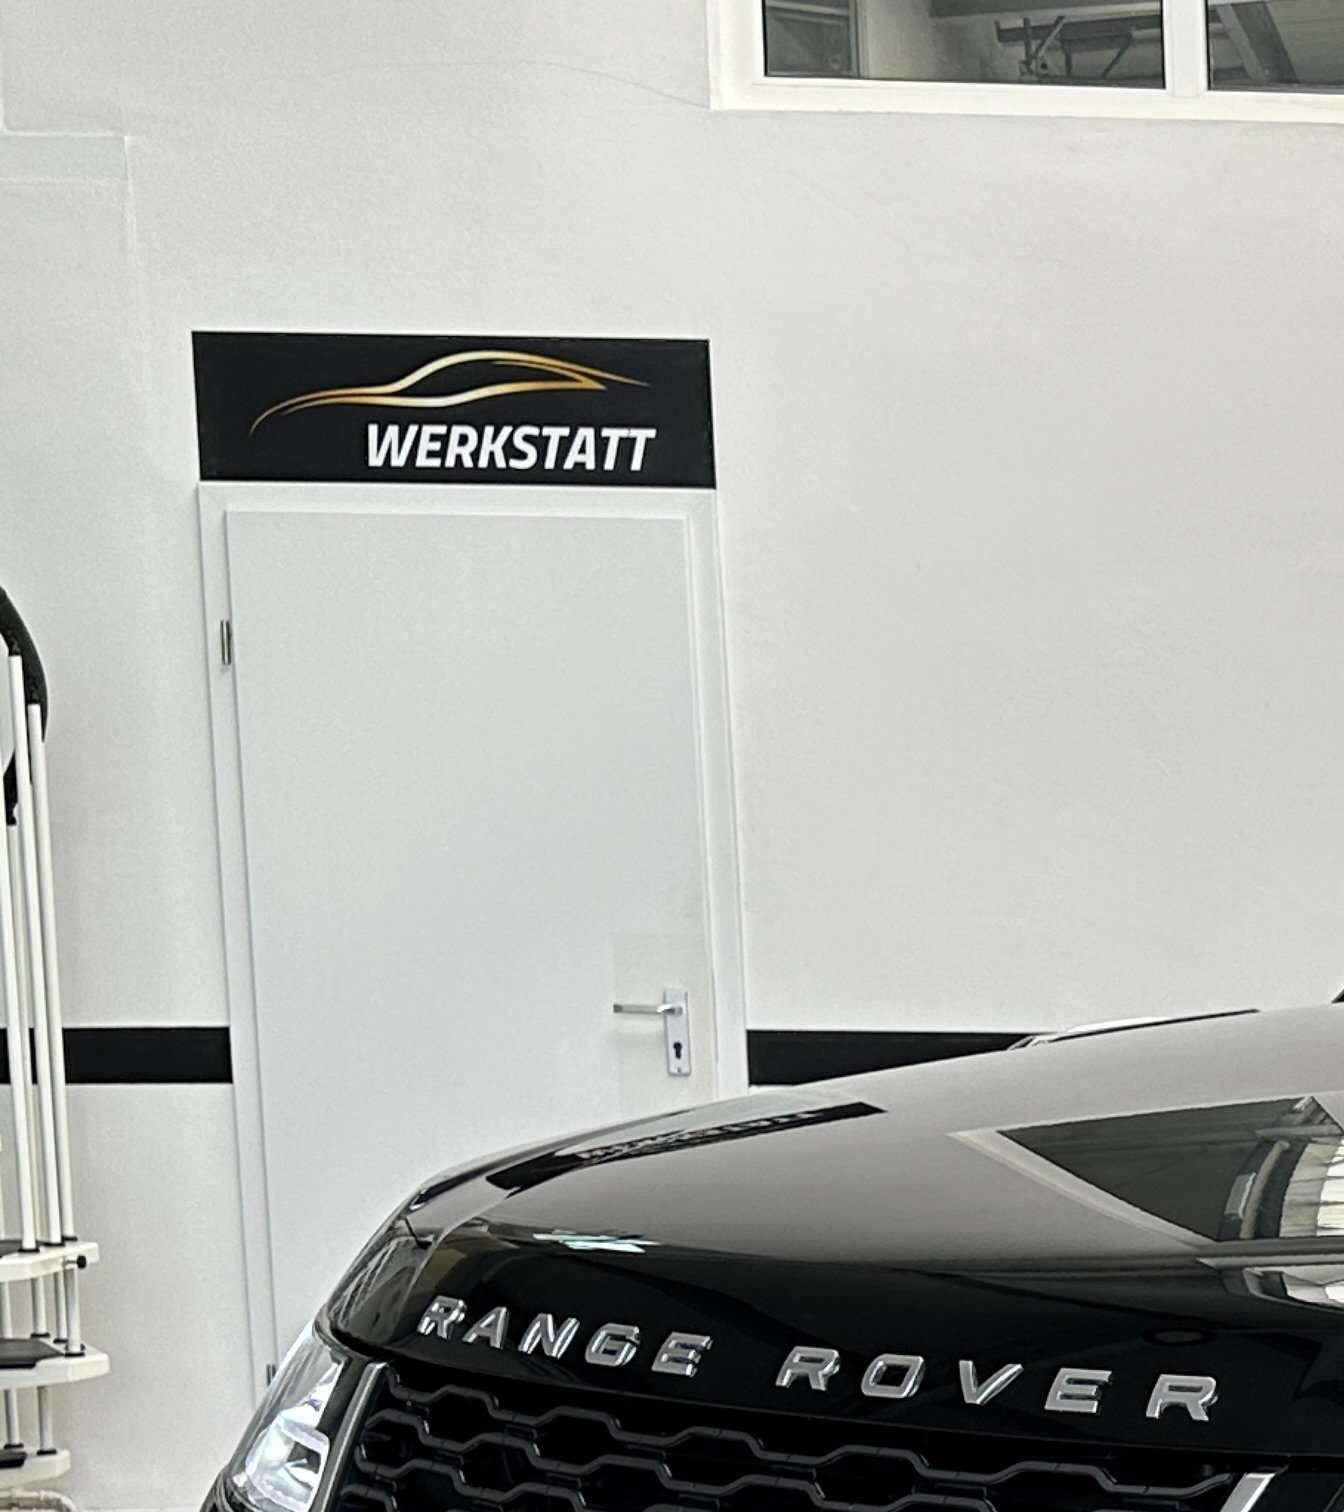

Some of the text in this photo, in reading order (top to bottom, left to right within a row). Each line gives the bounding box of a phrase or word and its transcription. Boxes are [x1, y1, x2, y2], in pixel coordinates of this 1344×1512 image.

[366, 423, 657, 472] WERKSTATT
[416, 1295, 1219, 1422] RANGE ROVER
